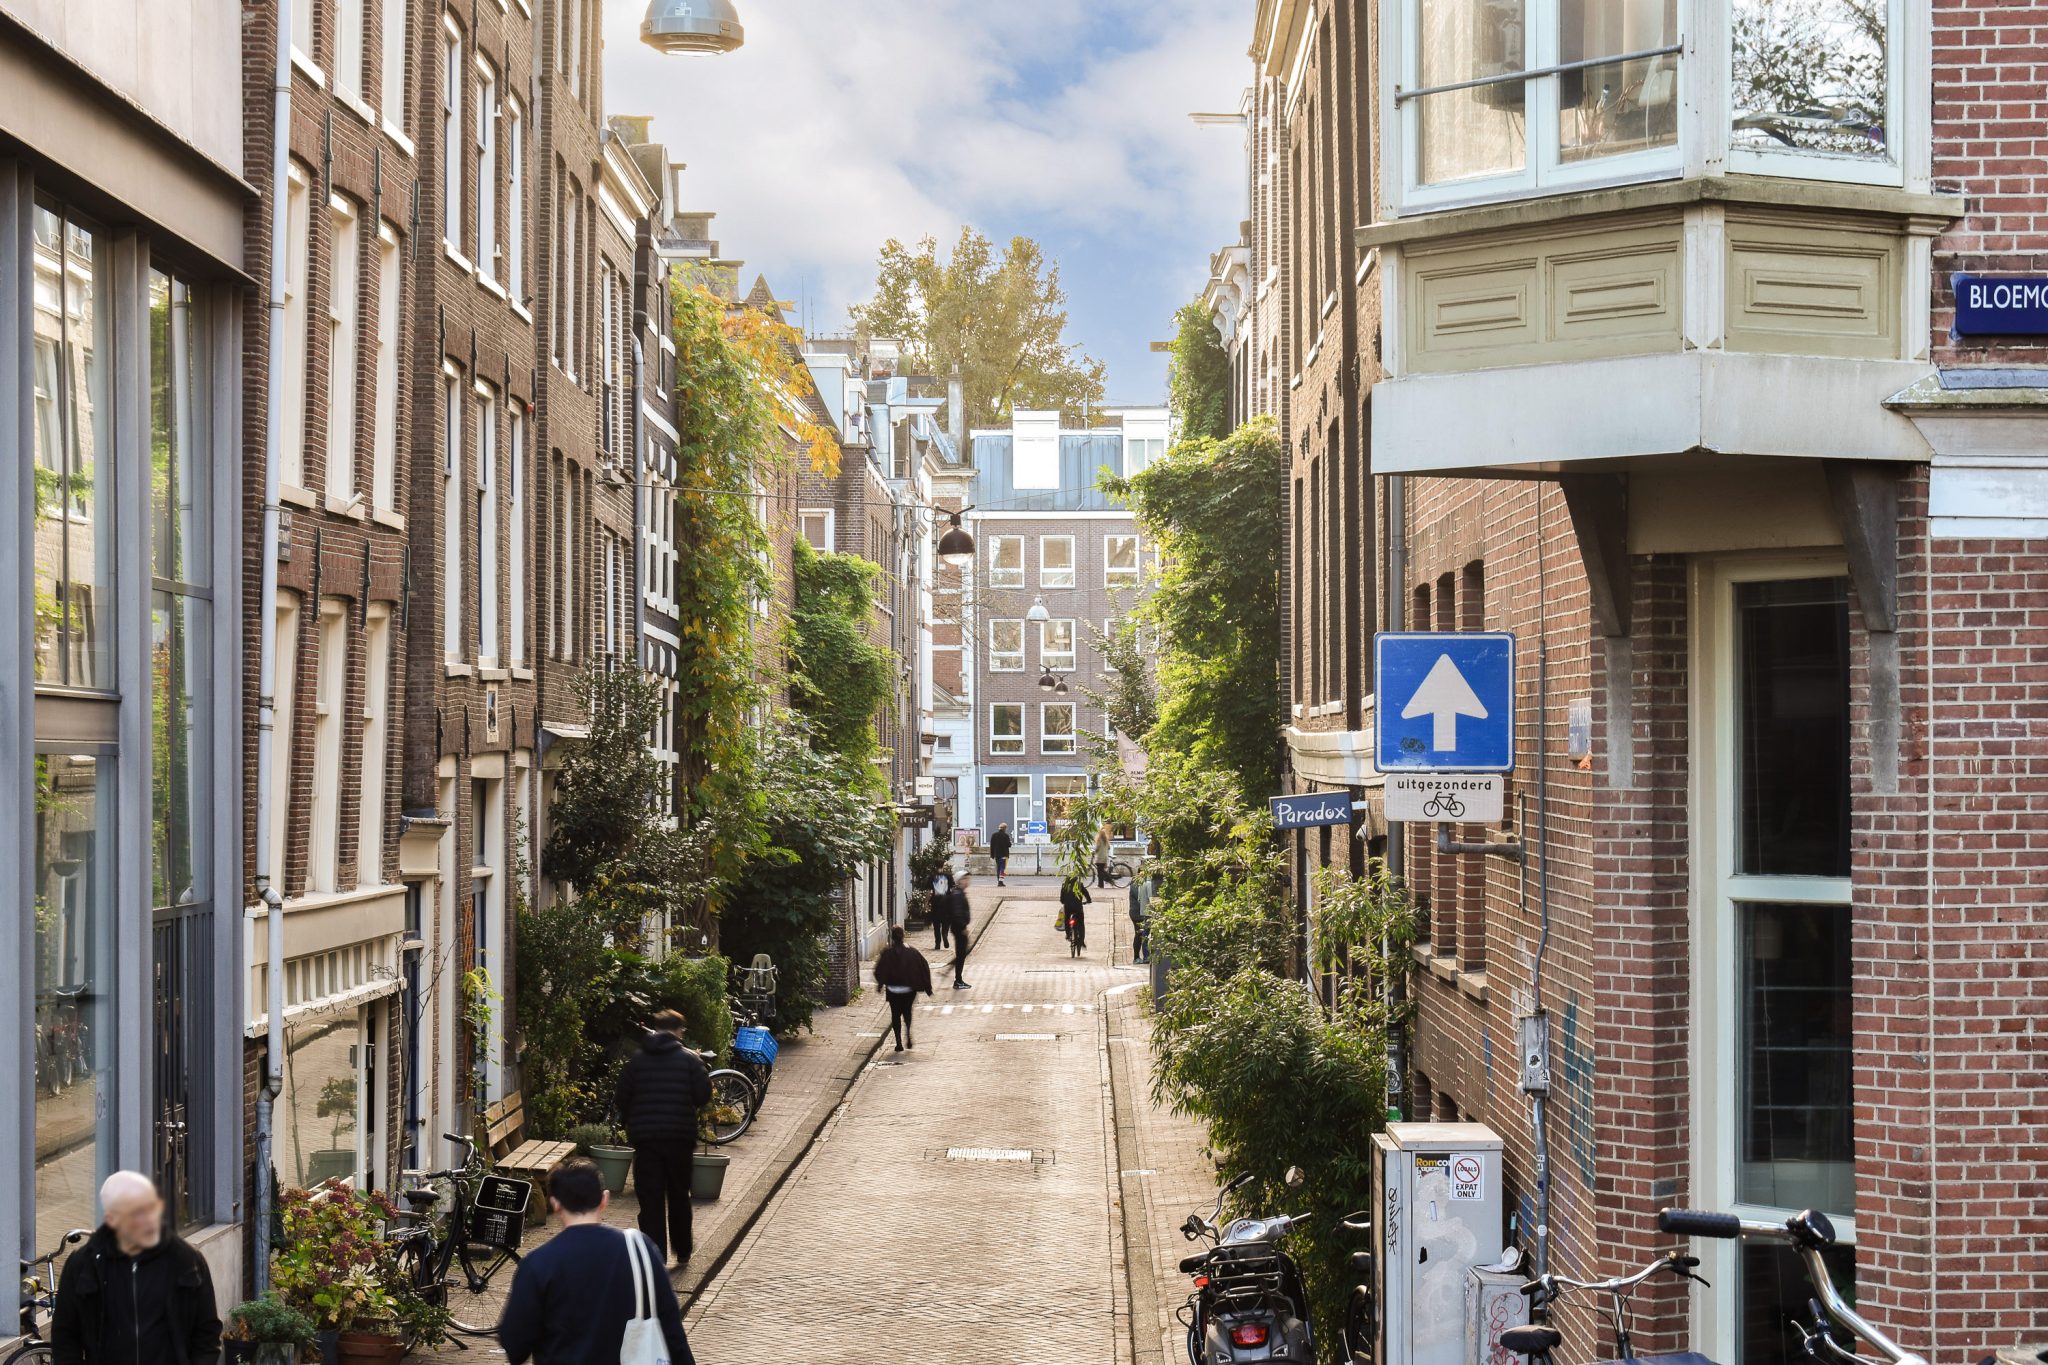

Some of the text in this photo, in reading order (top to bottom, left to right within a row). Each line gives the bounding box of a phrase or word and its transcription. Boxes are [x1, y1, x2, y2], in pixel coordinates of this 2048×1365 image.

[1397, 780, 1492, 792] uitgezonderd
[1276, 802, 1348, 826] Paradox
[1416, 1158, 1450, 1167] Romco
